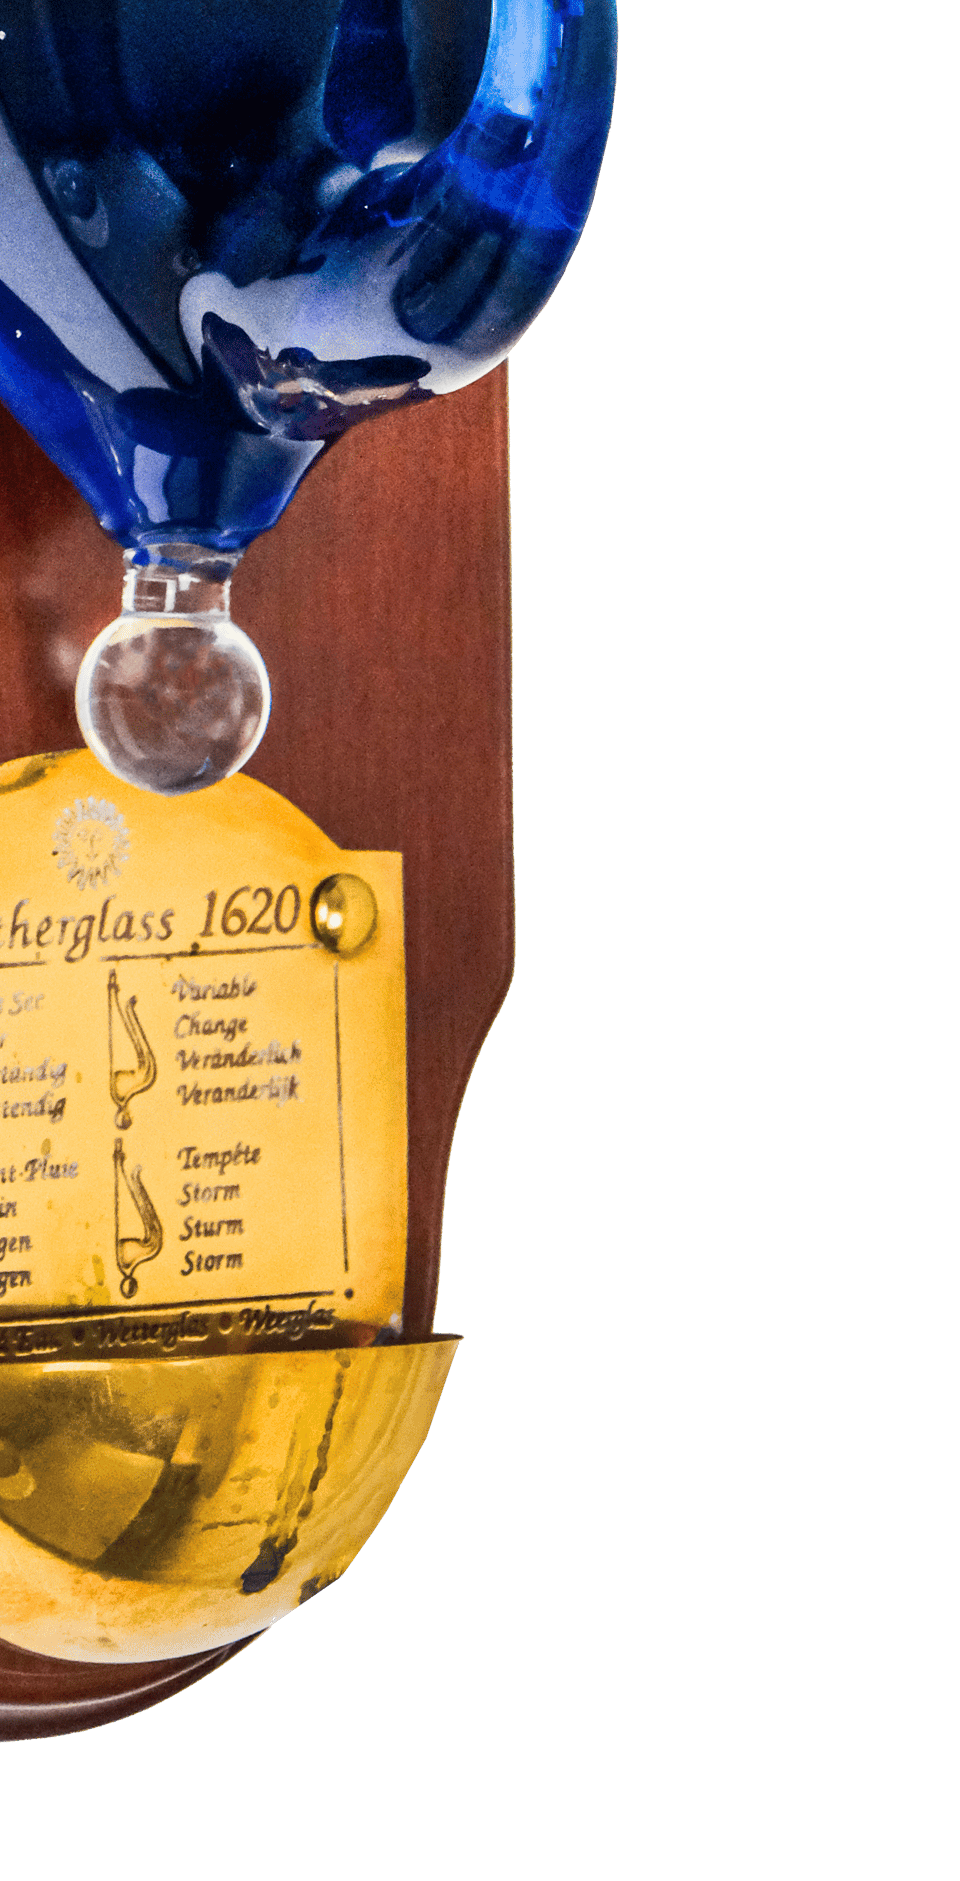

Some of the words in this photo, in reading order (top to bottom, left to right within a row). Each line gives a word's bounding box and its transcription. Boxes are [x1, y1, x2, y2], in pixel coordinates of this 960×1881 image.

[198, 884, 301, 939] 1620
[174, 1011, 248, 1042] Change
[176, 1182, 240, 1207] Storm
[179, 1215, 244, 1241] Sturm
[180, 1250, 243, 1276] Storm
